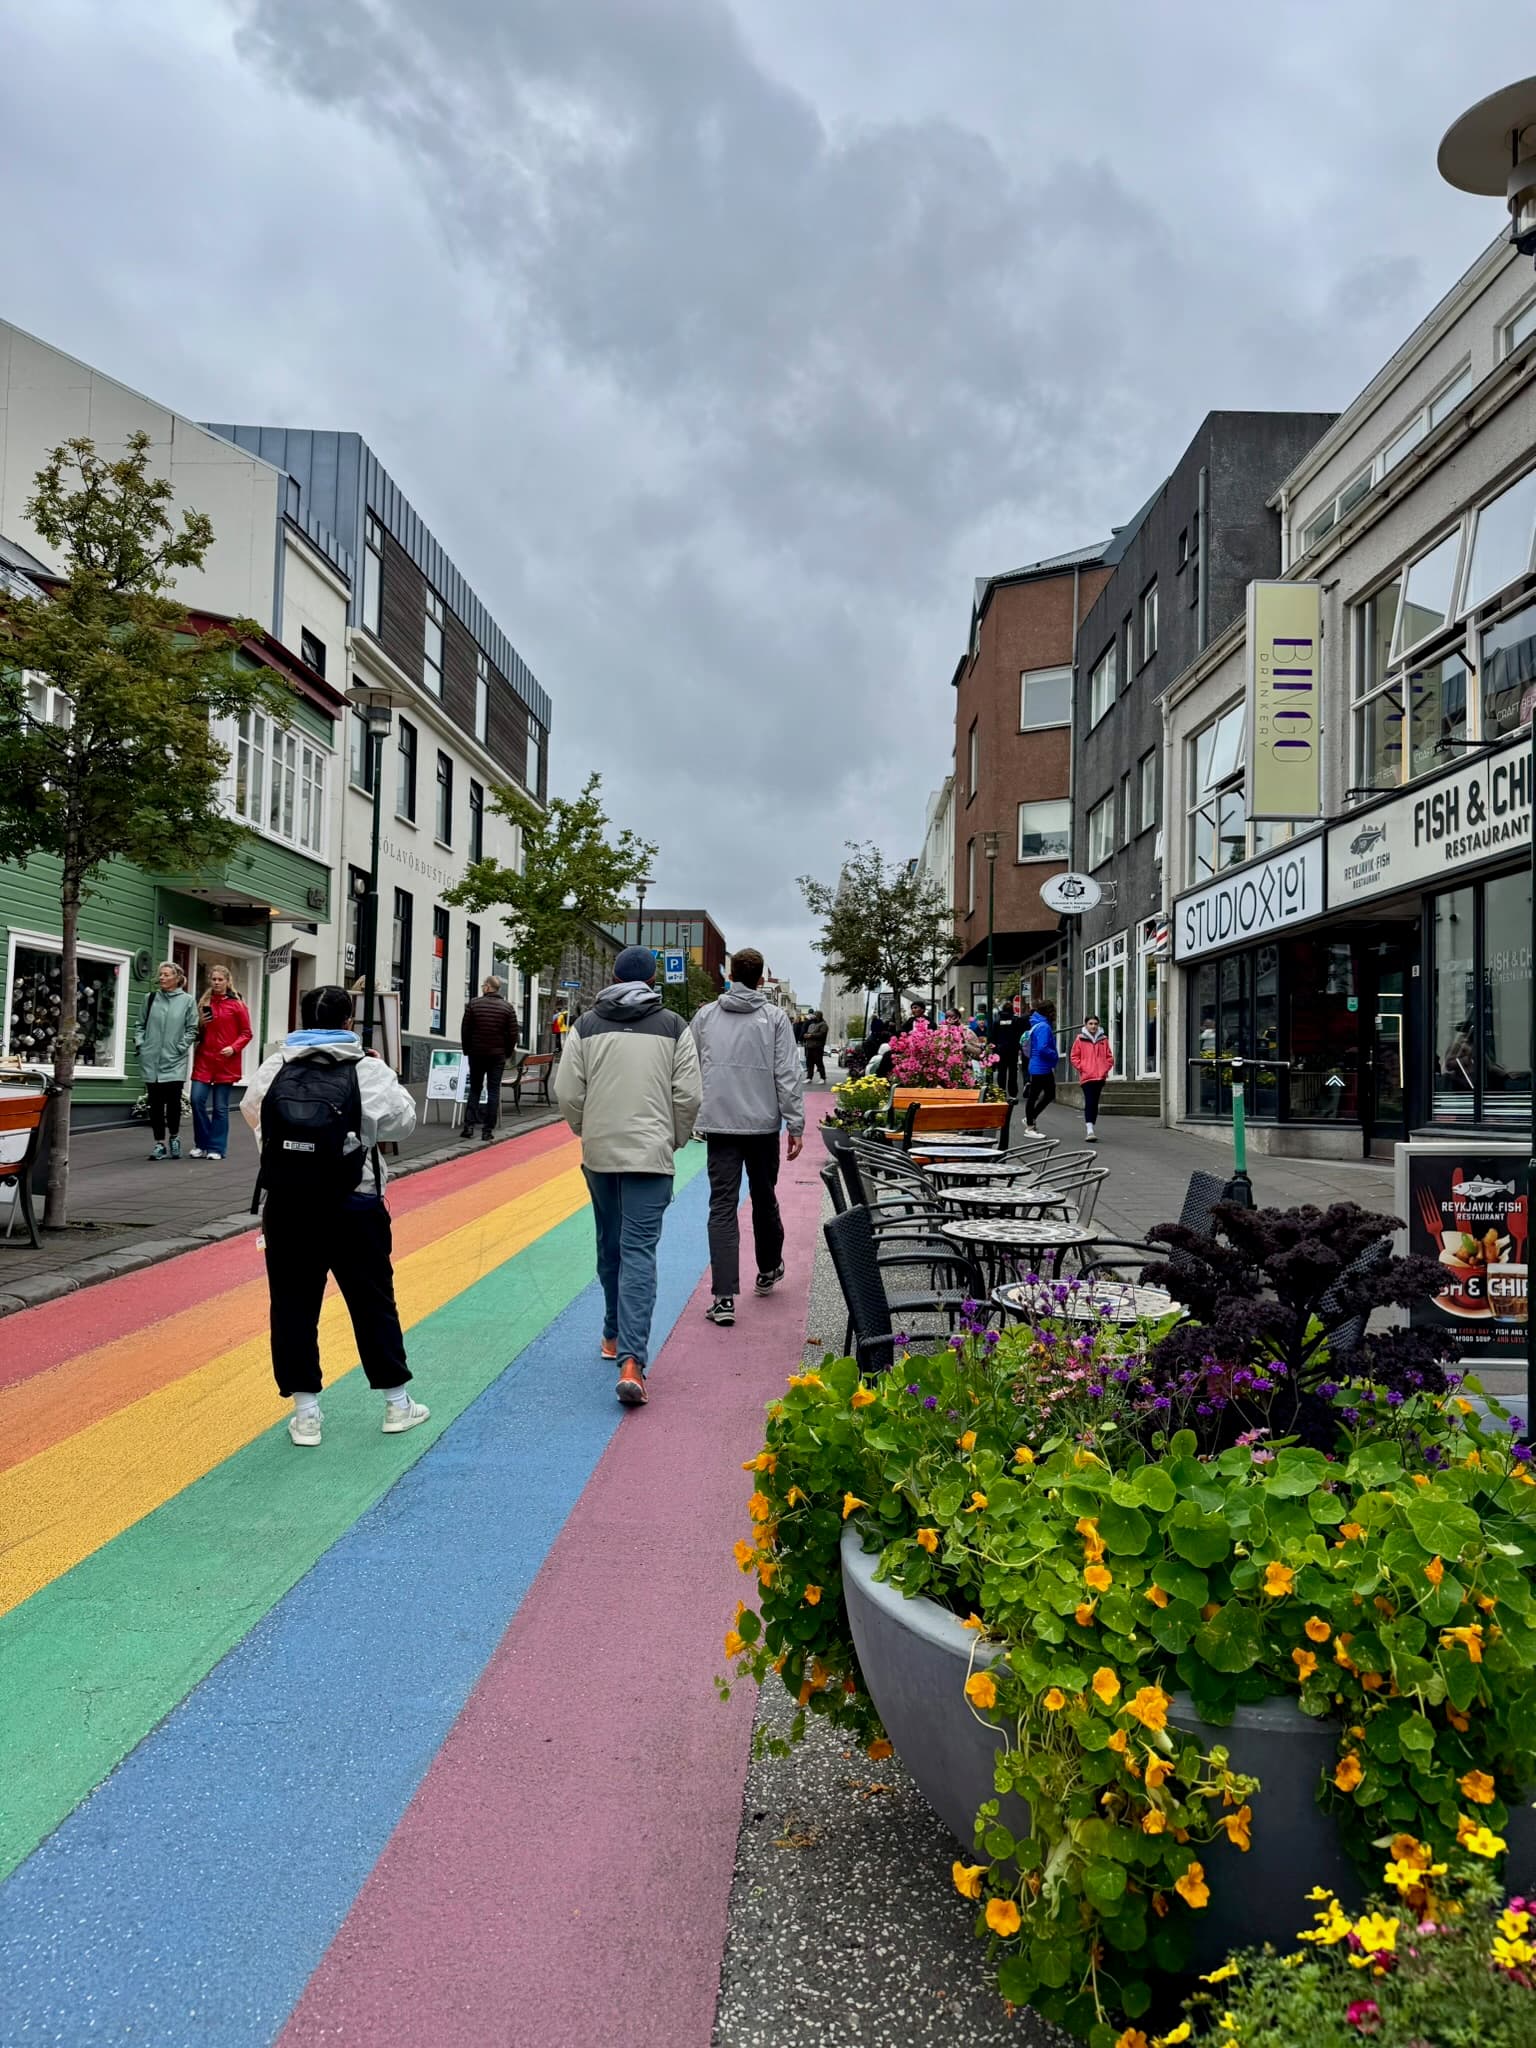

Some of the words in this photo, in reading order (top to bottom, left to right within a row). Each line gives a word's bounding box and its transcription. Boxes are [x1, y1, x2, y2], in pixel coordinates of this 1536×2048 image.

[1259, 653, 1269, 747] DRINKERY
[1272, 638, 1313, 762] BINGO
[1497, 701, 1520, 722] CRAFT
[1414, 785, 1460, 848] FISH
[1467, 780, 1487, 826] &
[1445, 814, 1530, 861] RESTAURANT
[1344, 858, 1374, 881] REYKJAVIK
[1376, 852, 1391, 870] FISH
[670, 958, 679, 970] P
[1442, 1202, 1494, 1212] REYKJAVIK
[1499, 1201, 1522, 1212] FISH
[1468, 1278, 1480, 1296] &
